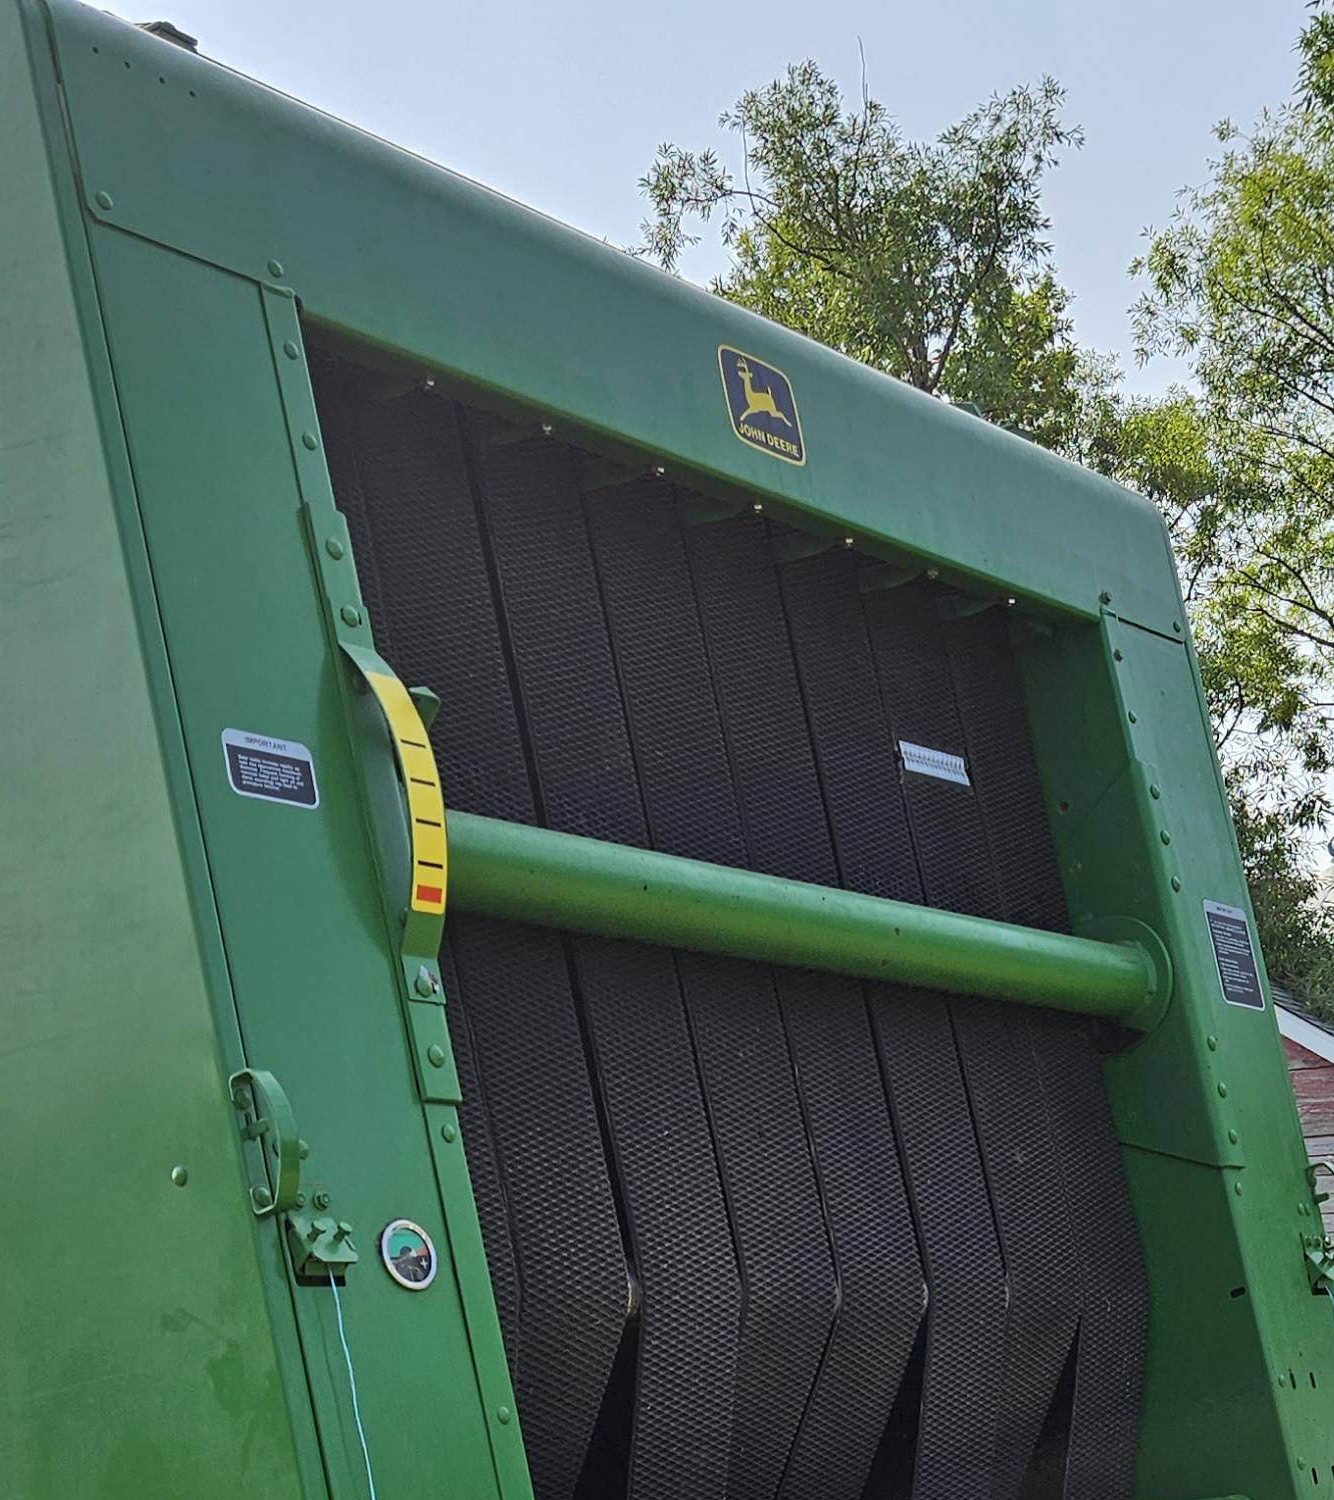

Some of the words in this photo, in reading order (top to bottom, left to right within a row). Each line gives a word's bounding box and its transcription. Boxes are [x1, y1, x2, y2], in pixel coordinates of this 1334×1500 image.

[738, 422, 766, 442] JOHN
[767, 434, 800, 457] DEERE
[245, 736, 287, 751] IMPORTANT
